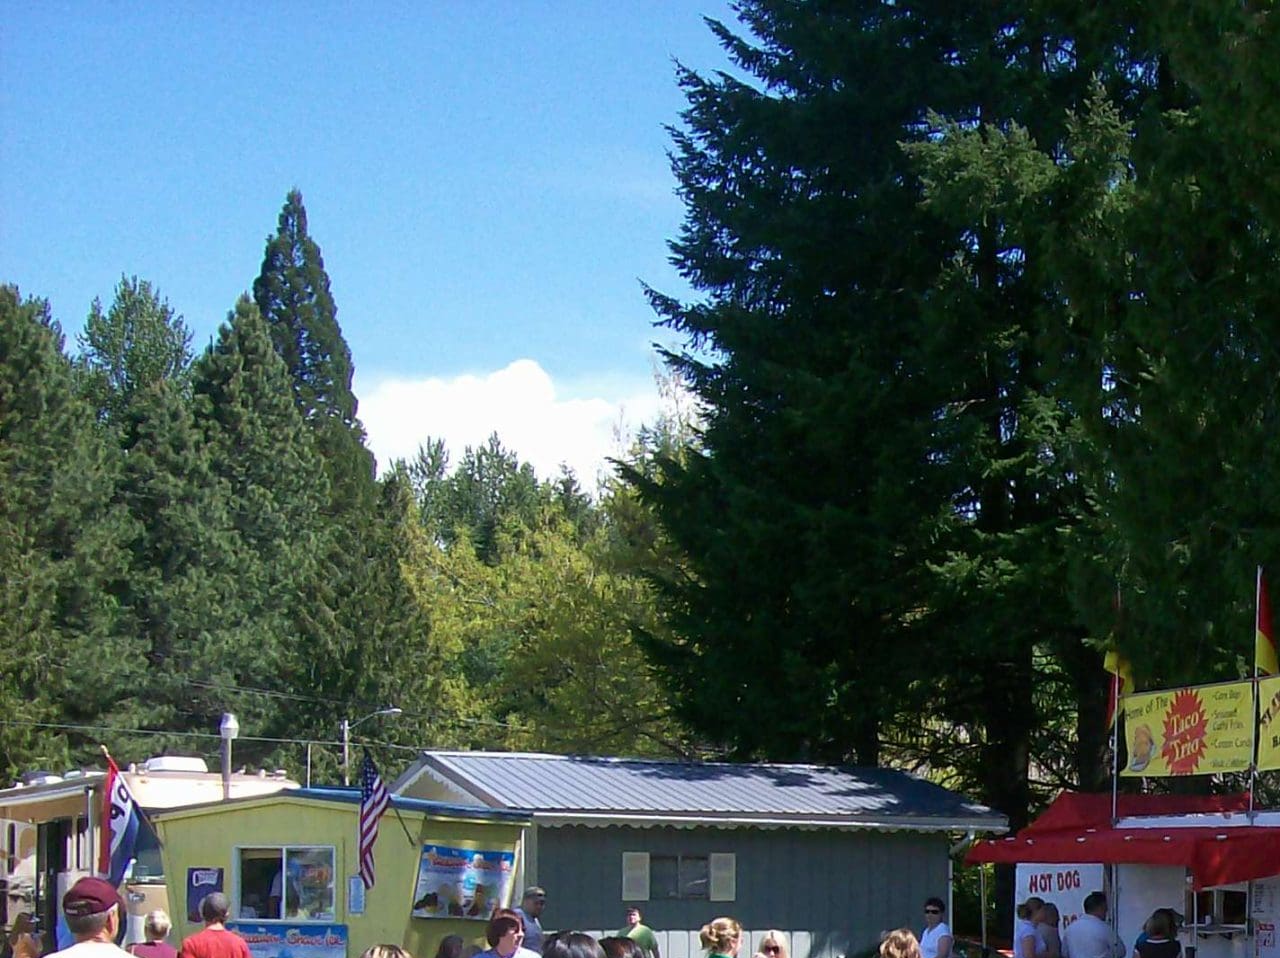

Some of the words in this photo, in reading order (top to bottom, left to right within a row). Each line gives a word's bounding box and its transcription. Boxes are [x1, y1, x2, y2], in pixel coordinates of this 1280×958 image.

[1171, 712, 1199, 737] Taco
[1171, 734, 1199, 761] Trio
[1029, 873, 1052, 894] HOT
[1056, 869, 1081, 891] DOG
